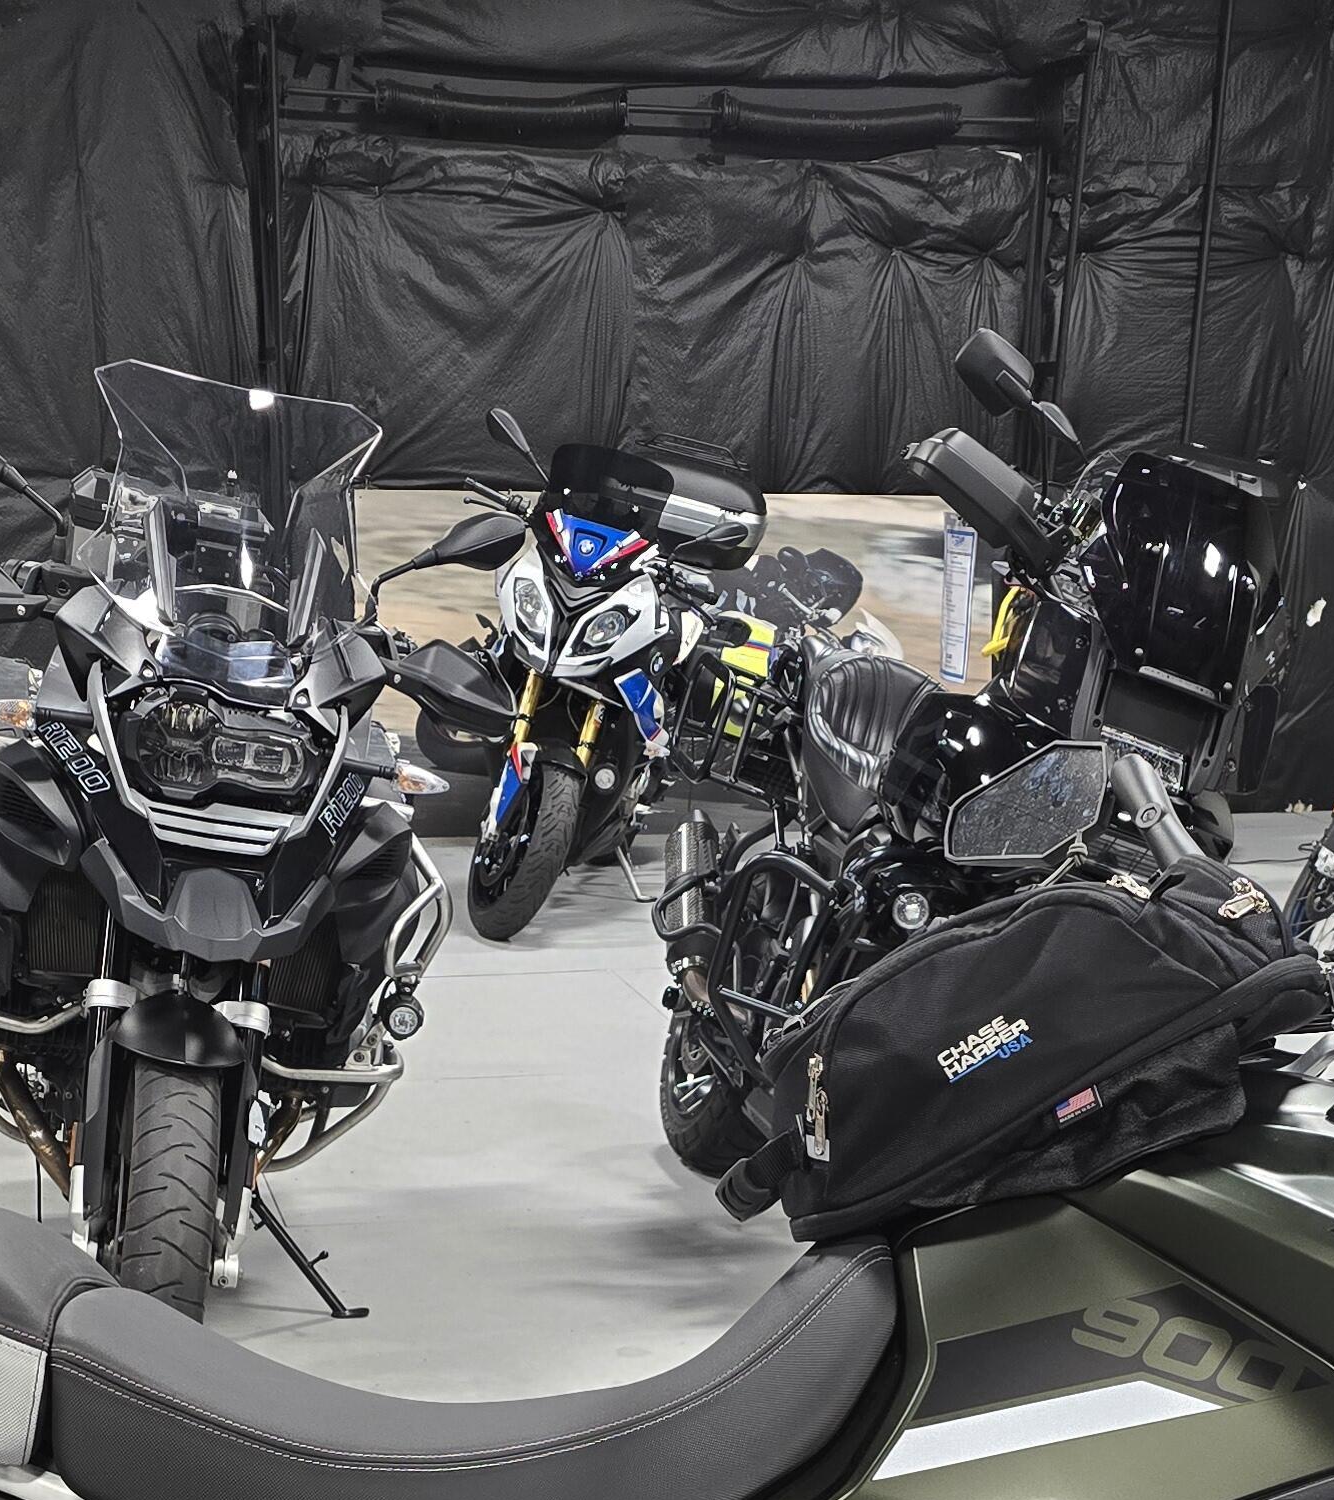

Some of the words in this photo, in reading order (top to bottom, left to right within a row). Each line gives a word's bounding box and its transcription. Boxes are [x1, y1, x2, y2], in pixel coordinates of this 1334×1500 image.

[38, 722, 111, 794] R1200
[937, 1015, 1009, 1067] CHASE
[943, 1018, 1030, 1080] HARPER
[997, 1033, 1033, 1060] USA
[1071, 1299, 1303, 1404] 900
